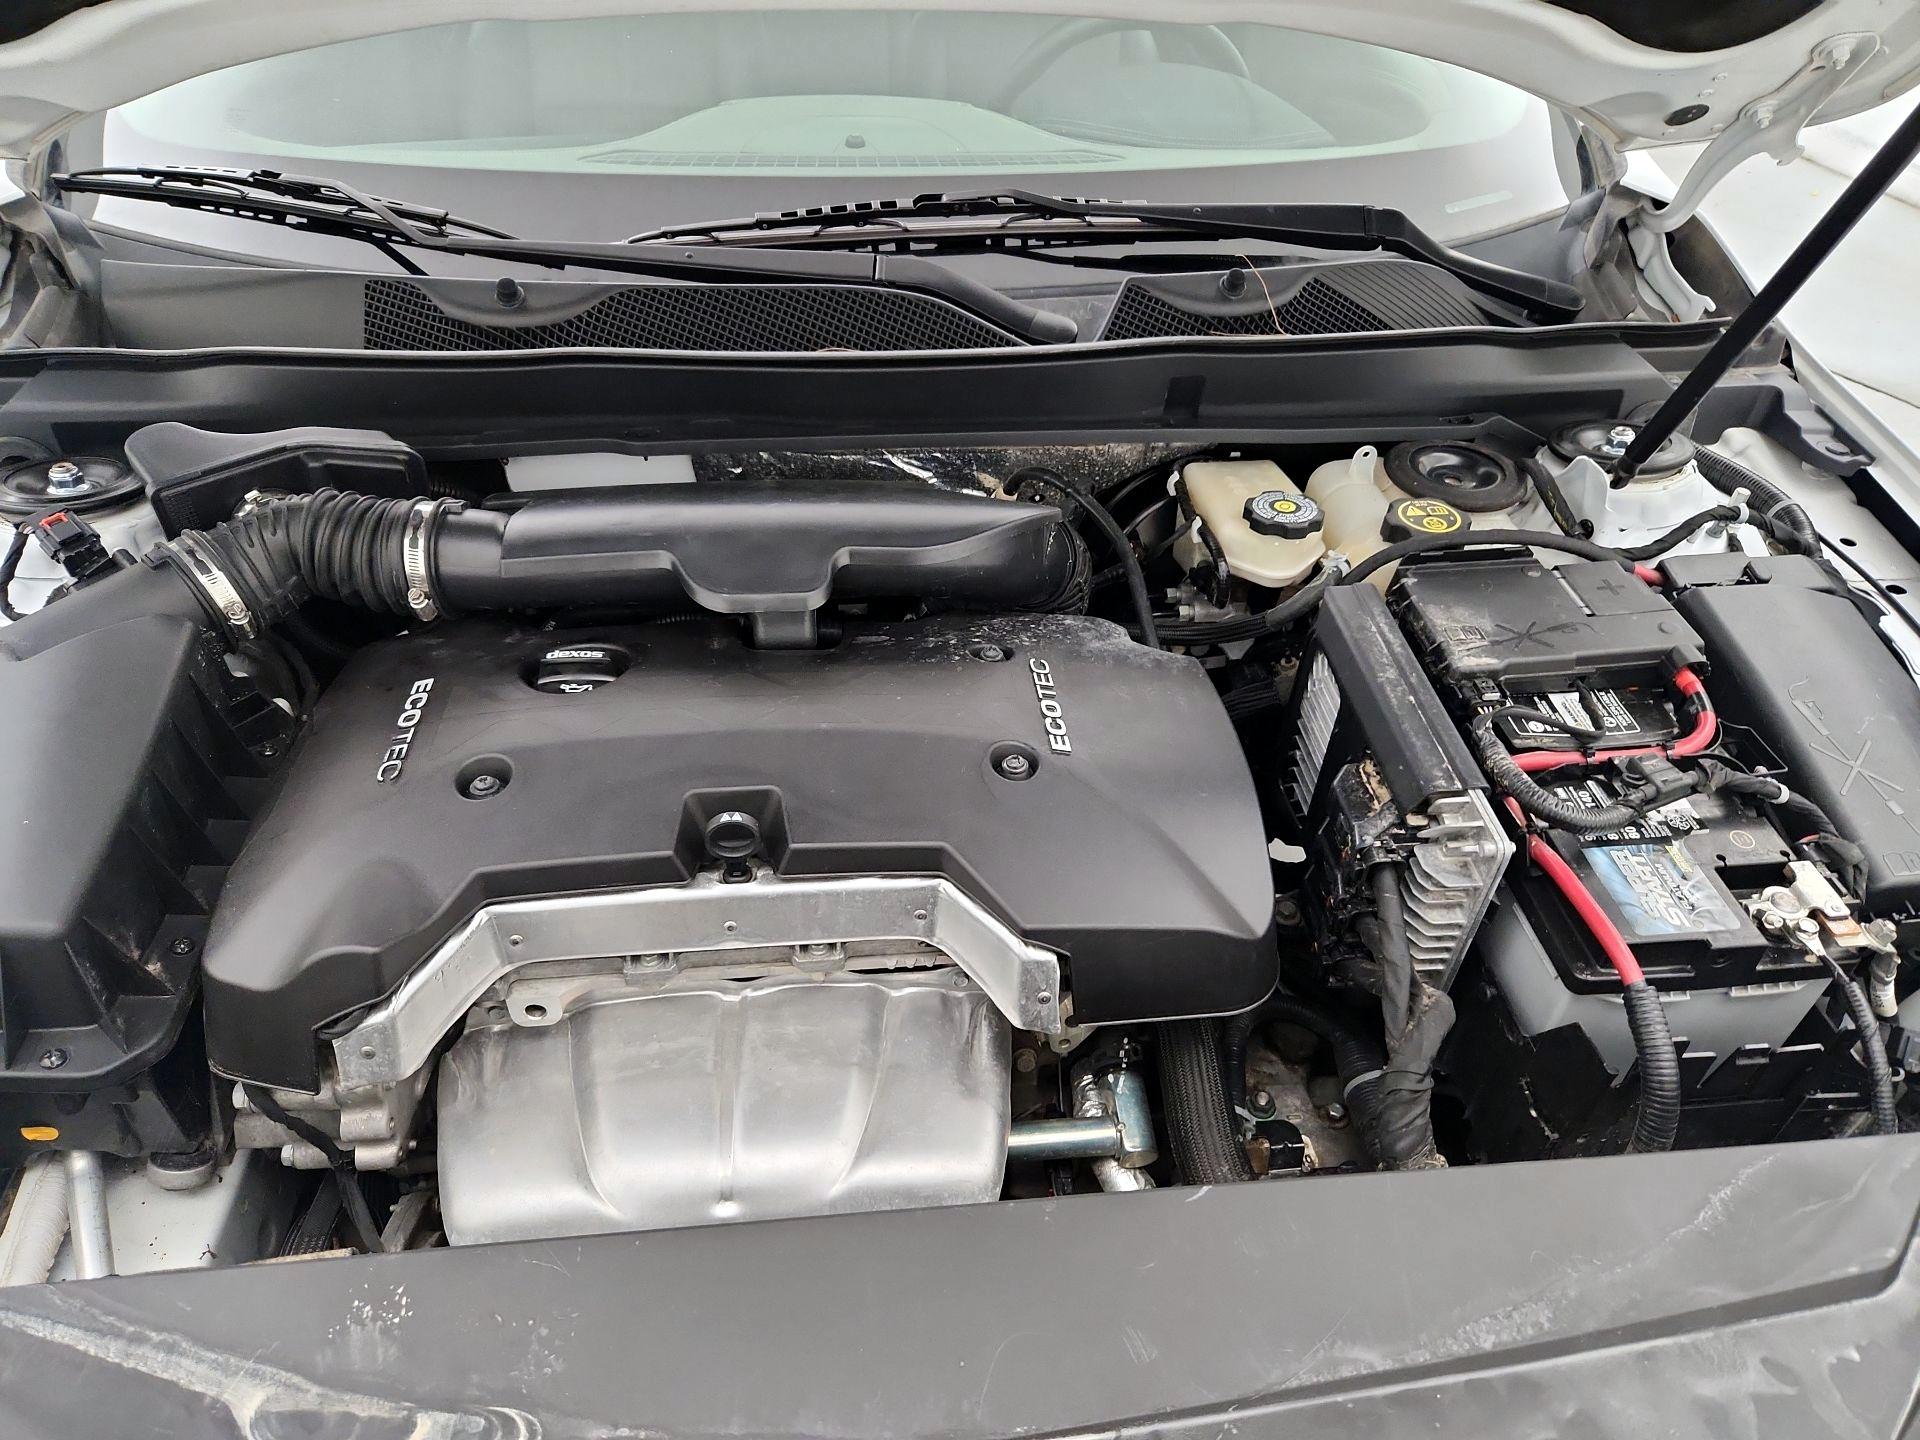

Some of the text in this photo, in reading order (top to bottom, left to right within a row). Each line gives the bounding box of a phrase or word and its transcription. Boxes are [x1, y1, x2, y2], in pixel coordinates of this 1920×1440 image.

[545, 648, 606, 660] dexos
[376, 677, 435, 783] ECOTEC
[1028, 657, 1073, 755] ECOTEC
[1578, 790, 1597, 808] 140
[1610, 849, 1661, 920] SUPER
[1623, 849, 1691, 928] START
[1655, 863, 1693, 909] PLATINUM
